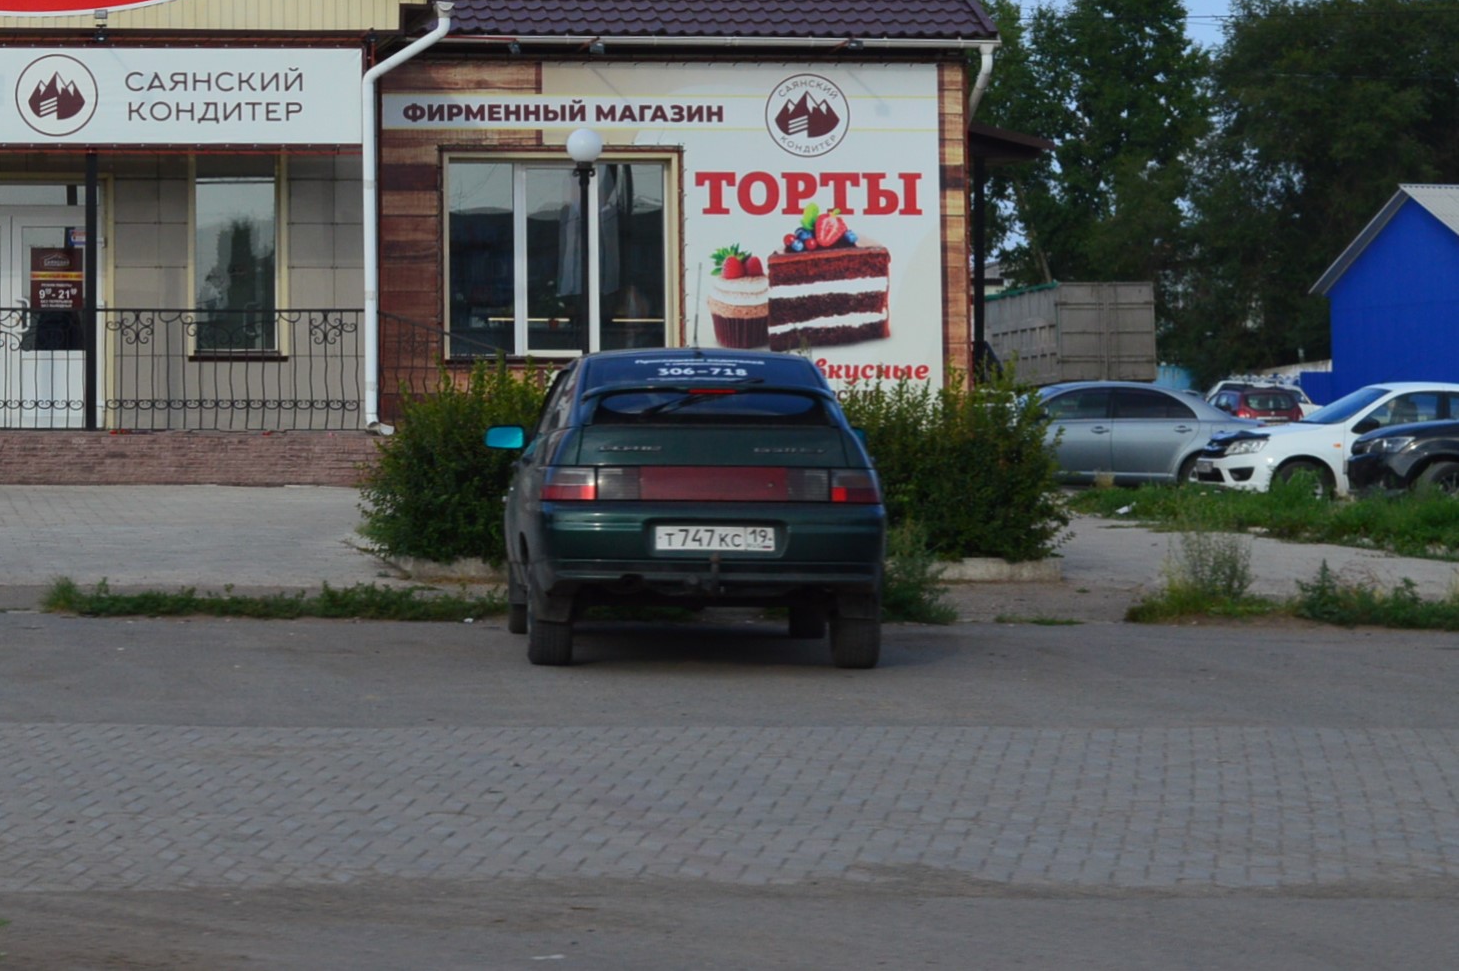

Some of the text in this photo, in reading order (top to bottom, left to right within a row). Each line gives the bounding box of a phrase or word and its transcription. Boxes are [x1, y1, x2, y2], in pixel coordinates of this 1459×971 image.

[125, 67, 303, 92] САЯНСКИЙ
[778, 79, 839, 100] САЯНСКИЙ
[128, 101, 303, 124] КОНДИТЕР
[402, 99, 724, 123] ФИРМЕННЫЙ МАГАЗИН
[780, 134, 837, 154] КОНДИТЕР
[695, 171, 923, 216] ТОРТЫ
